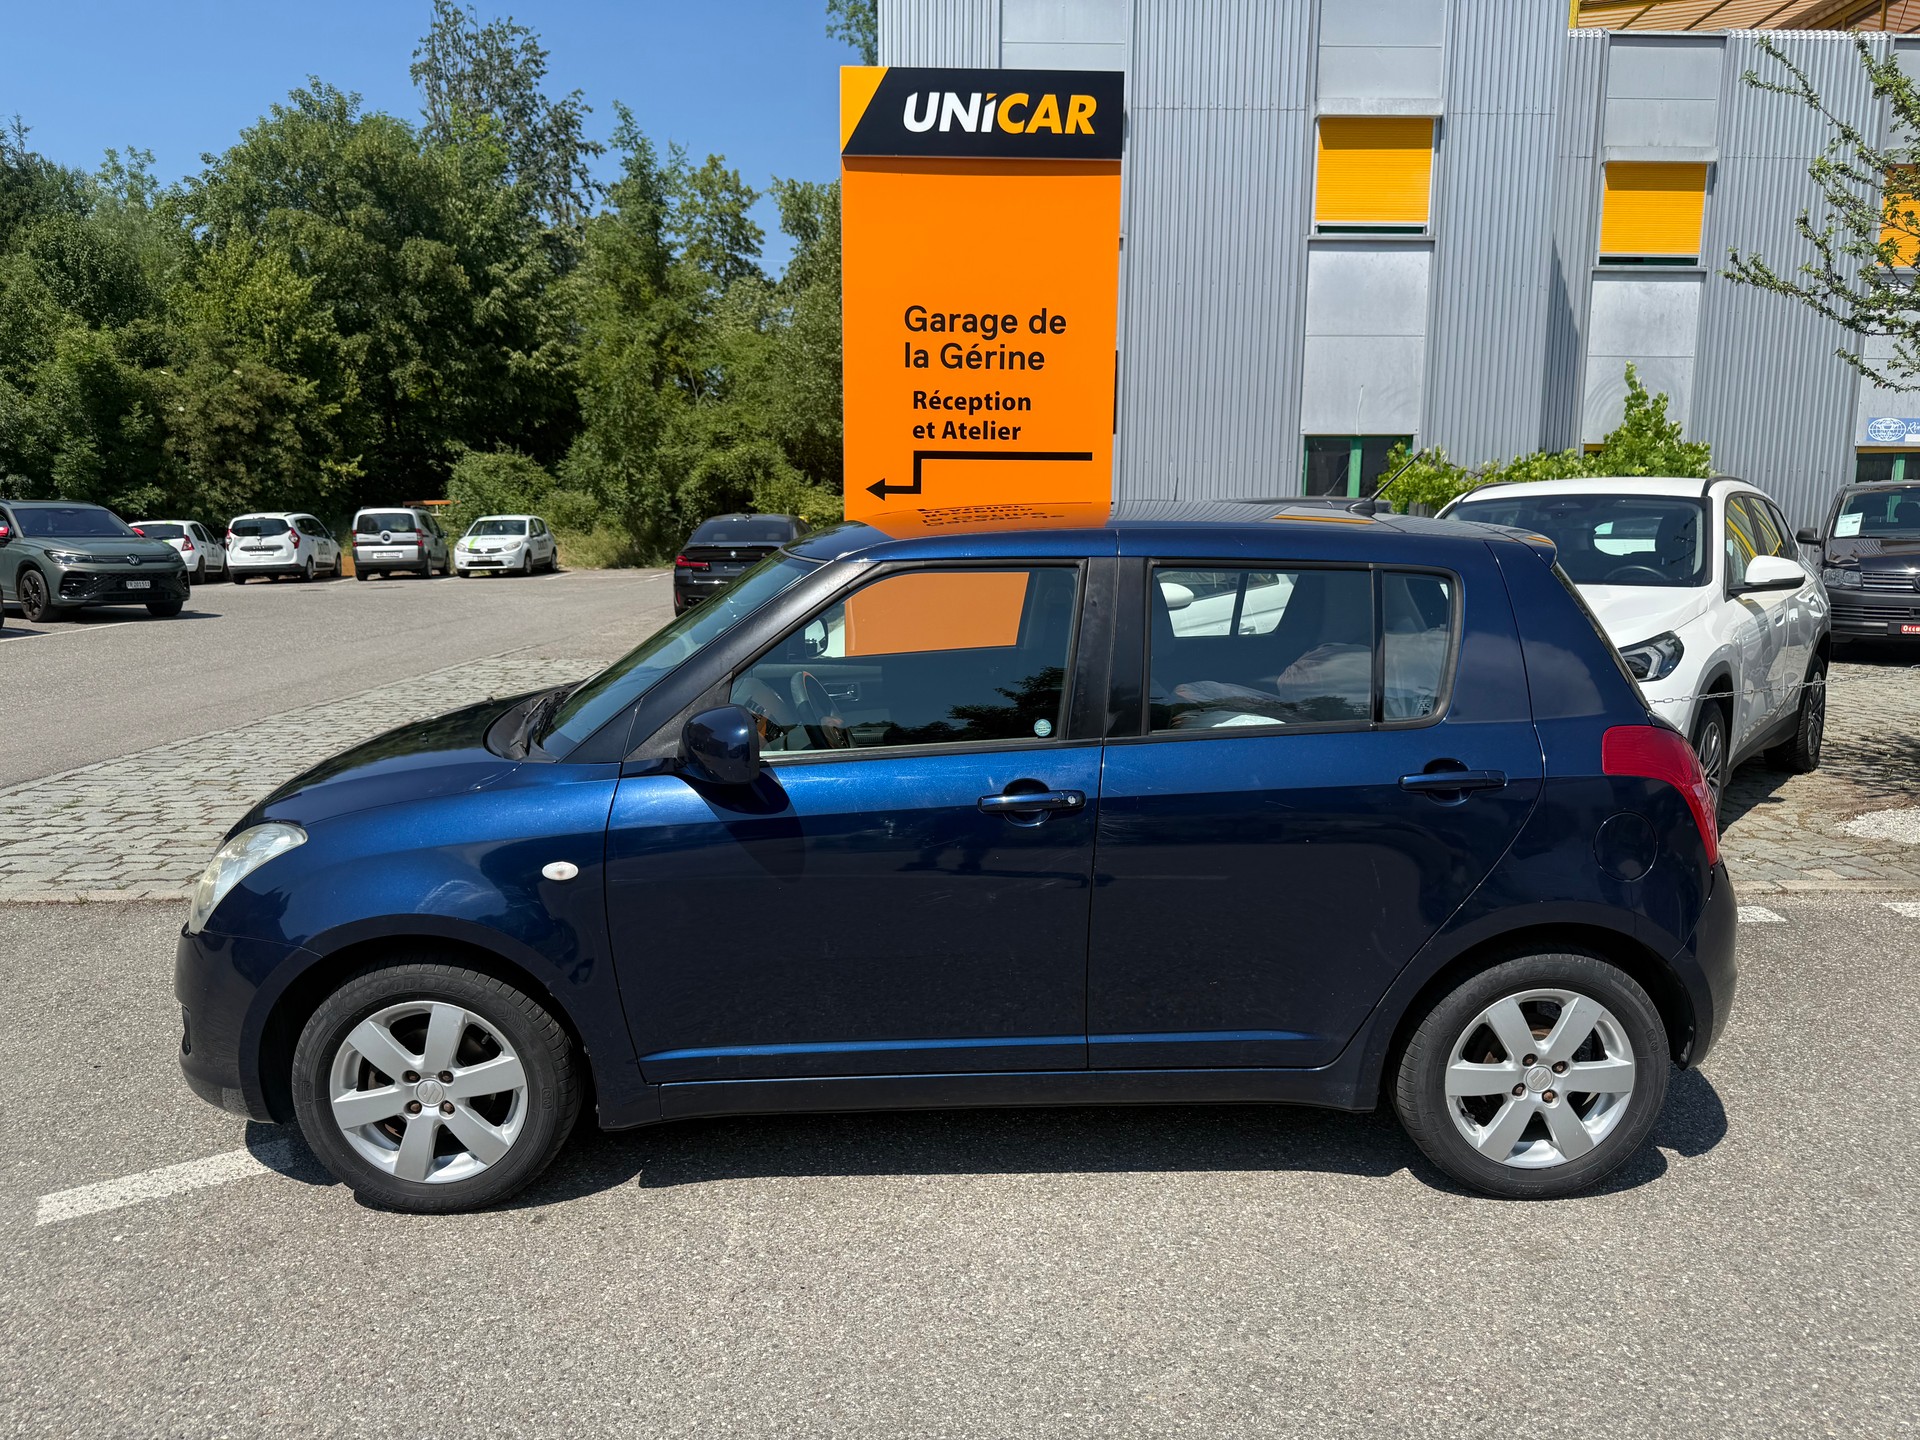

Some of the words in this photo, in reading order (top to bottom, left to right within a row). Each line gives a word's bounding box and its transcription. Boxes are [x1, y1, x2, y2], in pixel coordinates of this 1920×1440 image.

[904, 305, 1018, 341] Garage
[1029, 308, 1067, 335] de
[905, 342, 929, 368] la
[940, 342, 1045, 371] Gérine
[913, 390, 1031, 416] Réception
[912, 422, 935, 439] et
[941, 420, 1021, 440] Atelier
